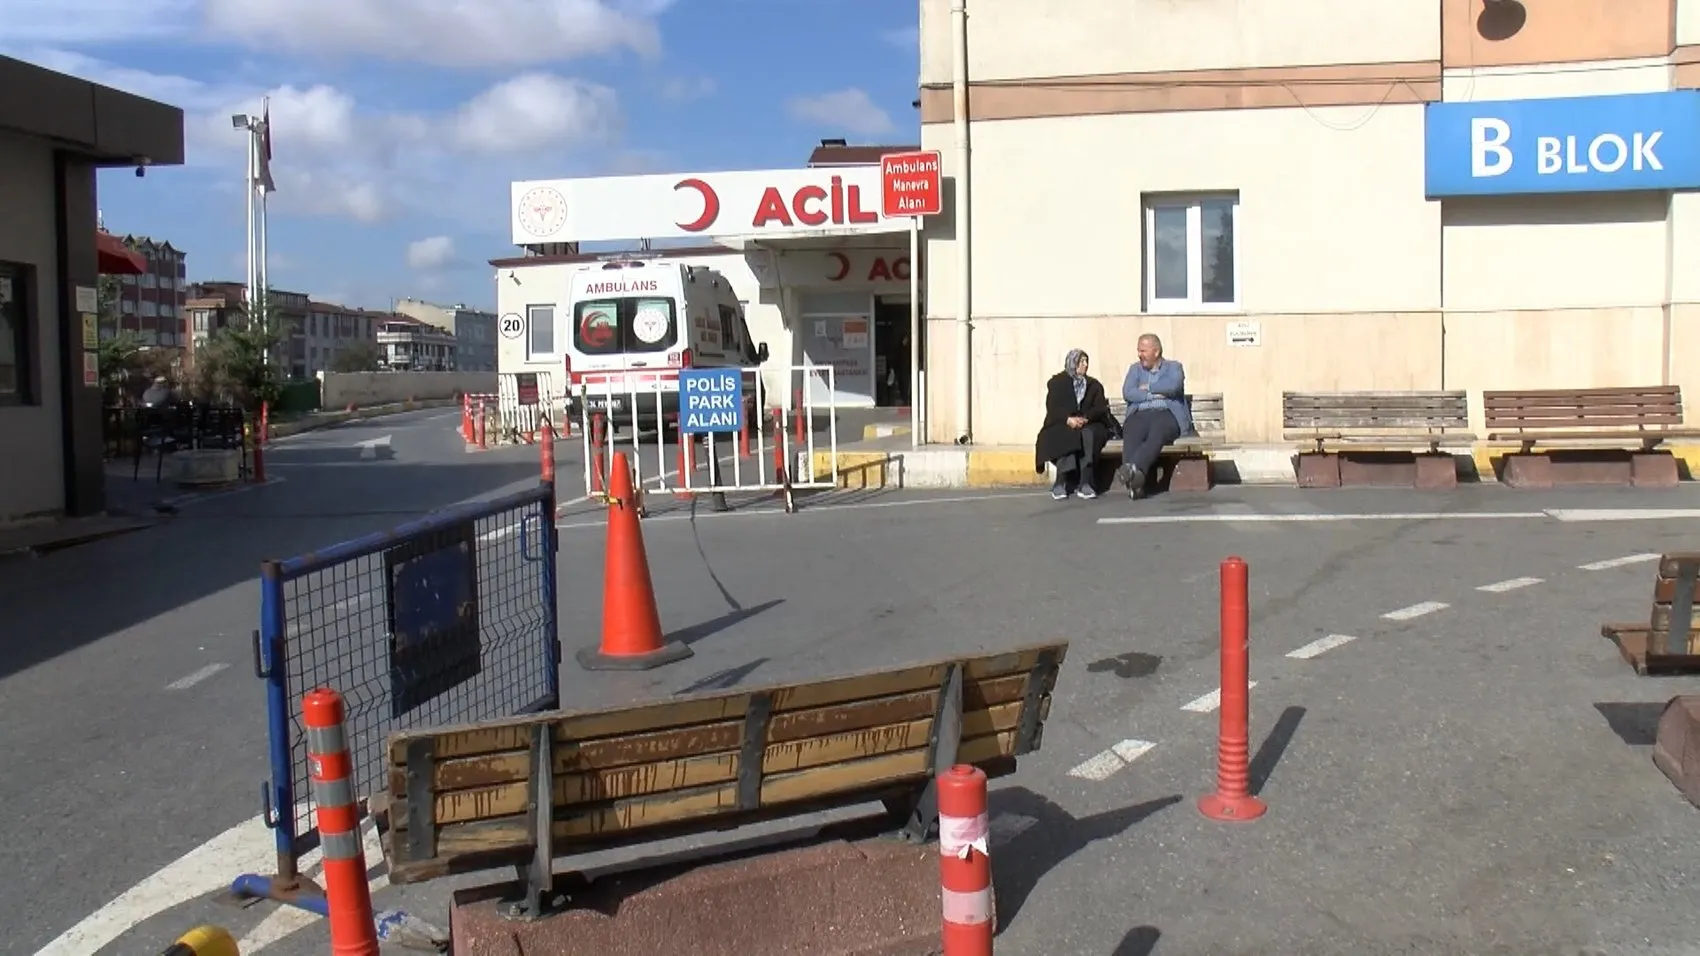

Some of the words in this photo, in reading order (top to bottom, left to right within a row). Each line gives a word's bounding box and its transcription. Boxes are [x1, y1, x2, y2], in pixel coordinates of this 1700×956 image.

[1471, 117, 1513, 178] B
[1537, 131, 1664, 175] BLOK
[885, 159, 938, 175] Ambulans
[893, 179, 929, 192] Manevra
[752, 175, 878, 227] ACİL
[898, 196, 925, 210] Alanı
[586, 280, 658, 294] AMBULANS
[503, 319, 520, 332] 20
[686, 374, 736, 392] POLİS
[689, 394, 734, 409] PARK
[687, 412, 737, 427] ALANI
